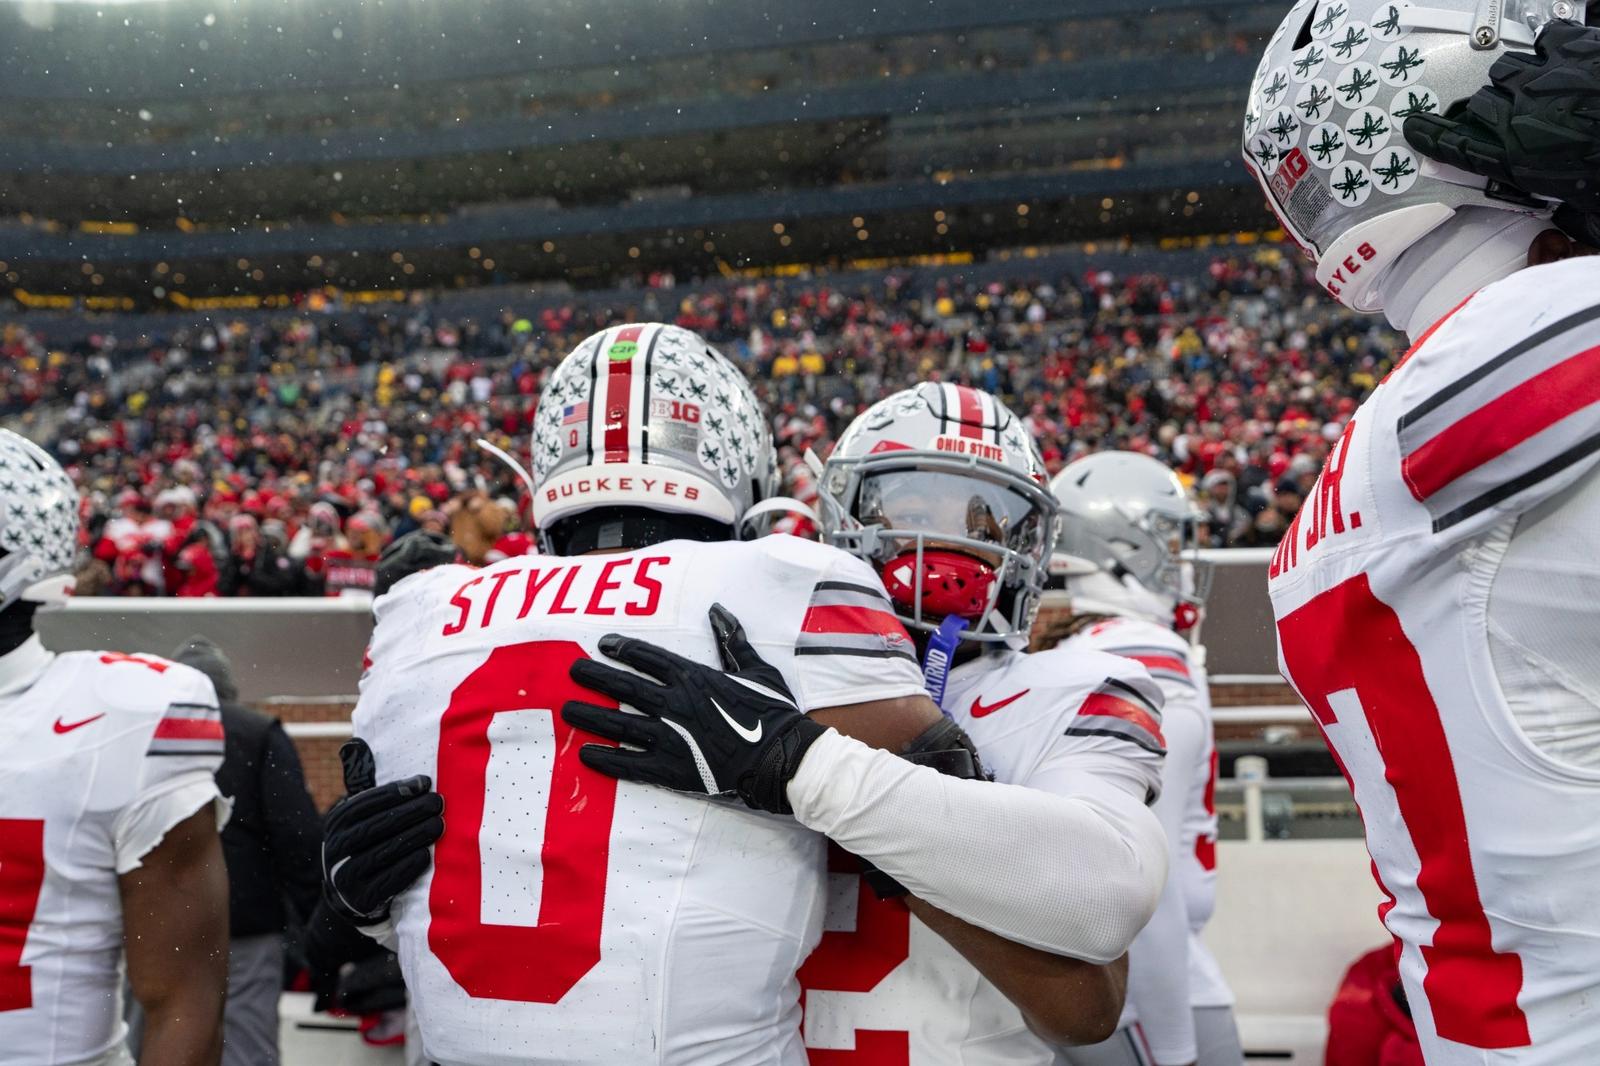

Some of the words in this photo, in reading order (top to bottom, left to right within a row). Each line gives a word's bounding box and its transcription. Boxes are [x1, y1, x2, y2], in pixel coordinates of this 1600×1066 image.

[936, 437, 965, 453] OHIO
[970, 442, 1003, 462] STATE
[546, 477, 699, 502] BUCKEYES
[442, 556, 671, 637] STYLES
[427, 639, 622, 1005] 0
